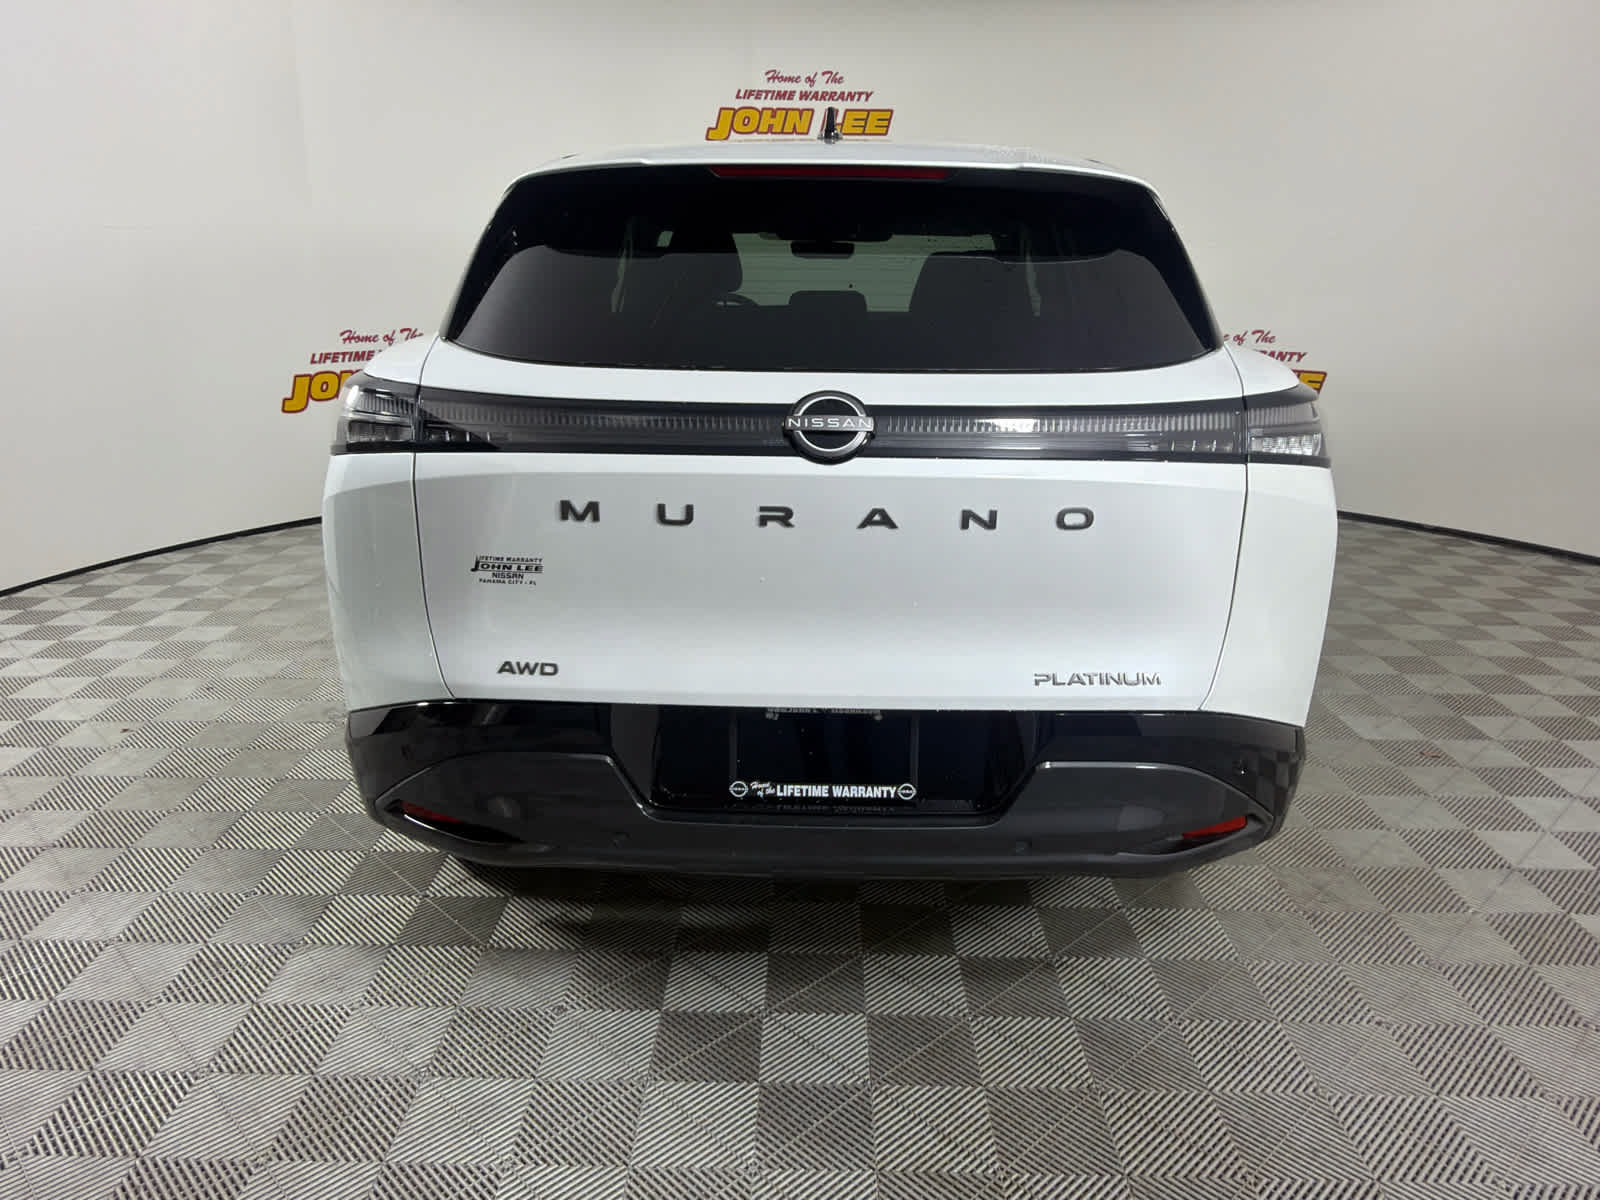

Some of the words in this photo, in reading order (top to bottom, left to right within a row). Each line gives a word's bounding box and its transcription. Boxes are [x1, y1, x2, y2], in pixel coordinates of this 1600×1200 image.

[764, 69, 801, 84] Home
[804, 71, 818, 88] of
[821, 70, 844, 85] The
[735, 89, 796, 101] LIFETIME
[798, 91, 875, 103] WARRANTY
[705, 106, 815, 141] JOHN
[339, 329, 380, 344] Home
[382, 330, 396, 346] of
[1232, 330, 1249, 346] of
[1251, 329, 1276, 344] The
[310, 350, 375, 364] LIFETIME
[788, 417, 873, 428] NISSAN
[558, 499, 1096, 531] MURANO
[470, 558, 513, 572] JOHN
[516, 564, 544, 572] LEE
[492, 572, 524, 580] NISSAN
[497, 660, 559, 677] AWD
[1033, 672, 1162, 687] PLATINUM
[776, 784, 830, 798] LIFETIME
[832, 785, 897, 799] WARRANTY
